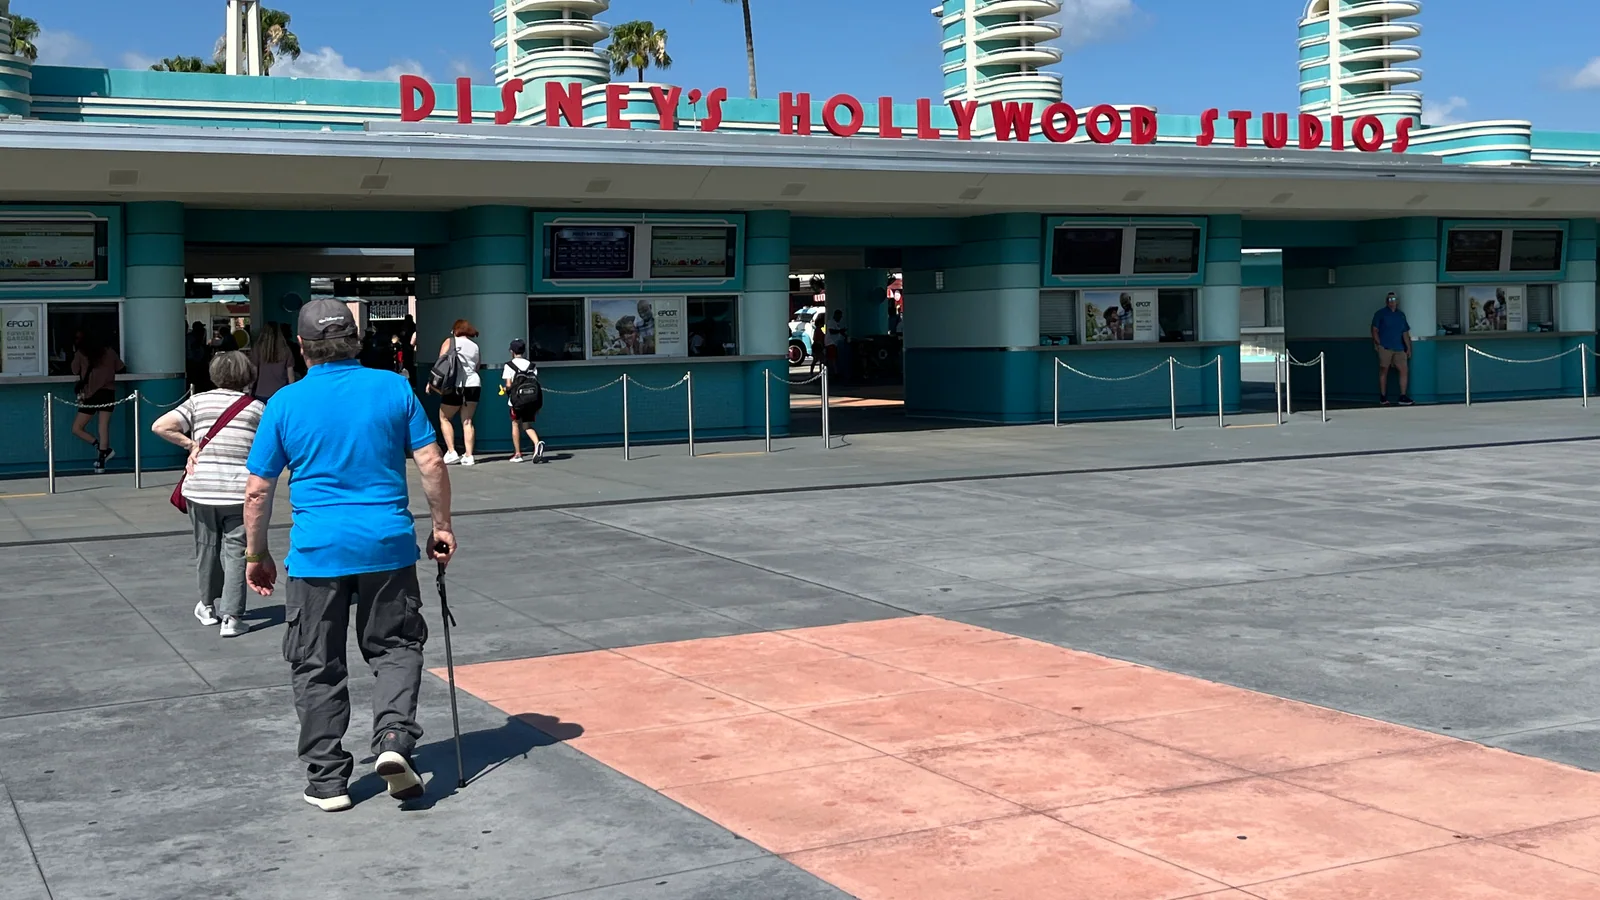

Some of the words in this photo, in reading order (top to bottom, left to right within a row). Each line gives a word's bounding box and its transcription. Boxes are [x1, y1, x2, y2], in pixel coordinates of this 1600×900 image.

[400, 74, 727, 131] DISNEY'S
[778, 91, 1158, 145] HOLLYWOOD
[1196, 108, 1413, 153] STUDIOS
